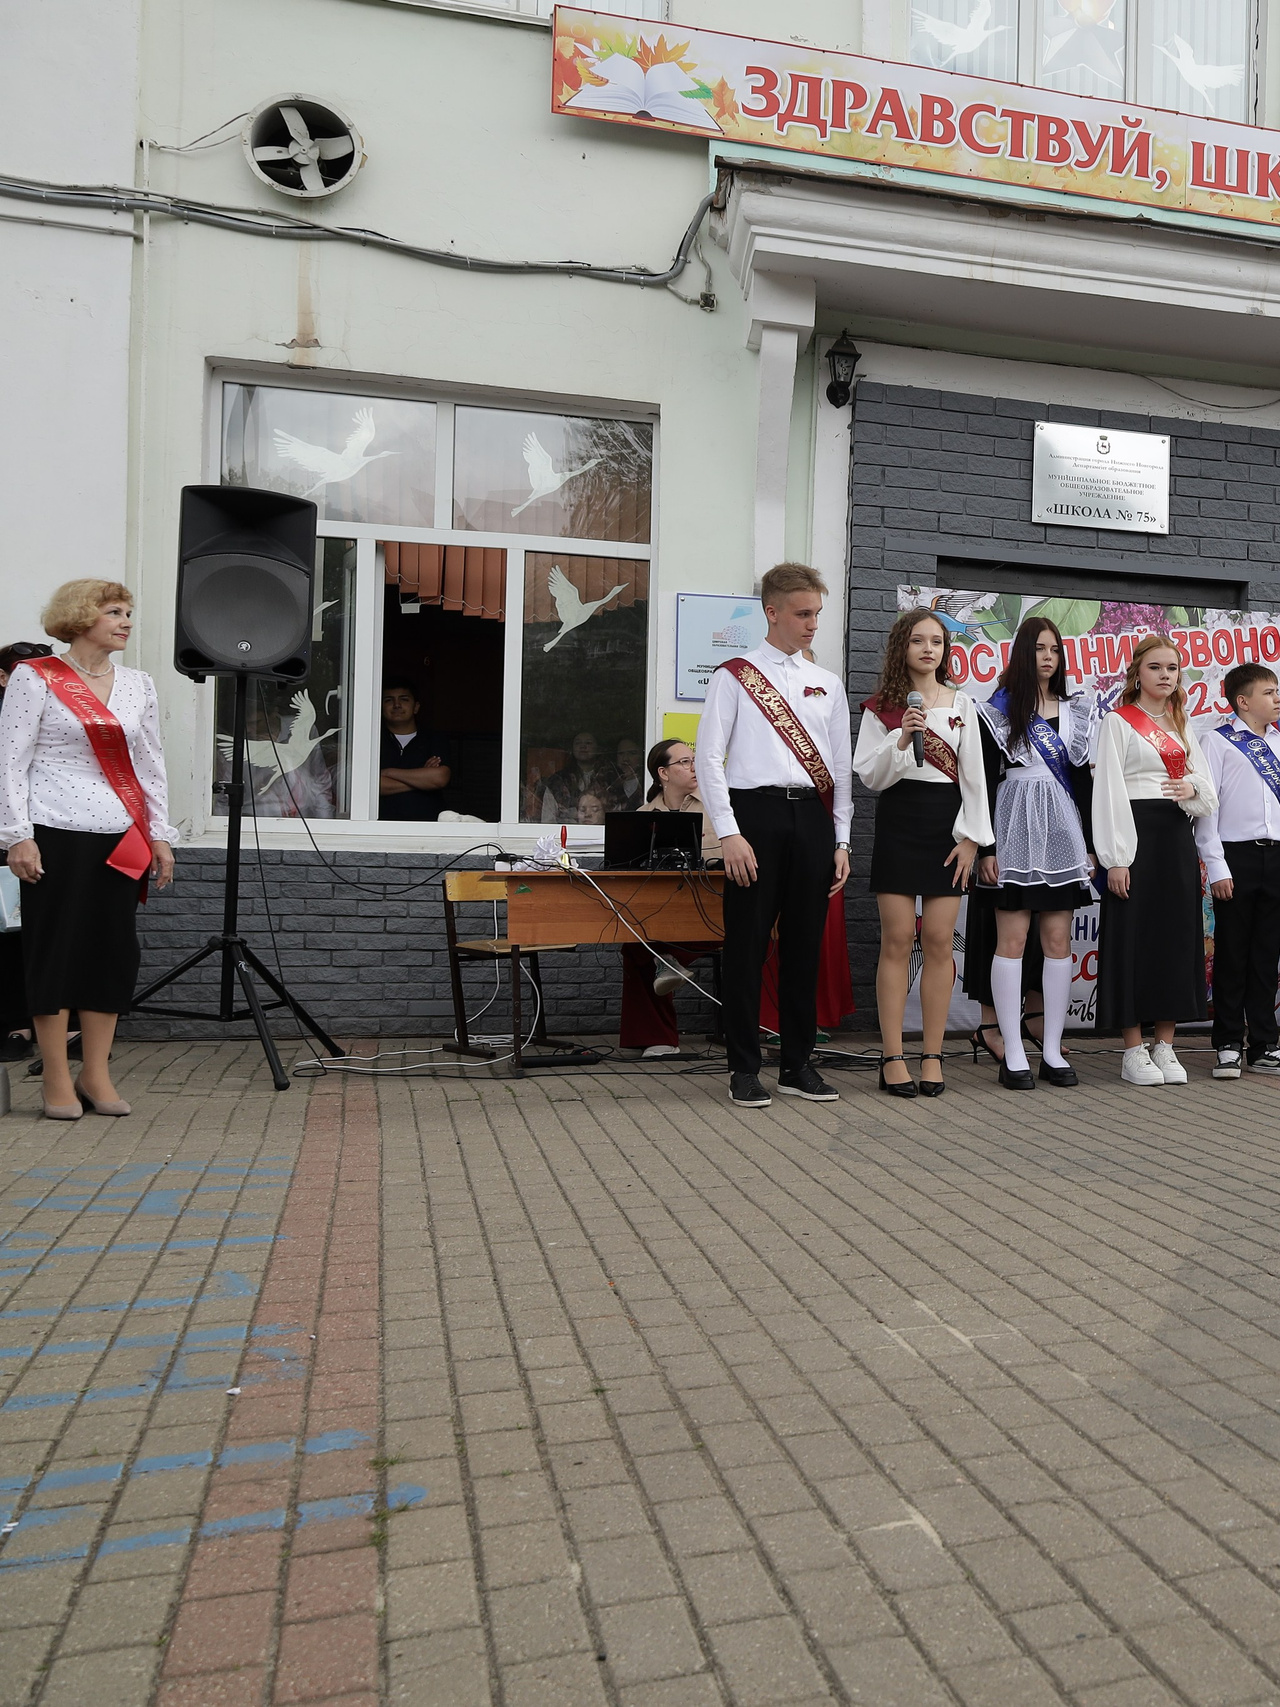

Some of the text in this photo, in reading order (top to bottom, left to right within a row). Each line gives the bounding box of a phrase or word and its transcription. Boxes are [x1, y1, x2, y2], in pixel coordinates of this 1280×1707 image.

[741, 66, 1169, 191] ЗДРАВСТВУЙ,
[1048, 473, 1111, 486] МУНИЦИПАЛЬНОЕ
[1060, 482, 1145, 496] ОБЩЕОБРАЗОВАТЕЛЬНОЕ
[1079, 491, 1126, 501] УЧРЕЖДЕНИЕ
[1046, 503, 1157, 523] «ШКОЛА № 75»
[756, 686, 833, 793] Выпускник 2025
